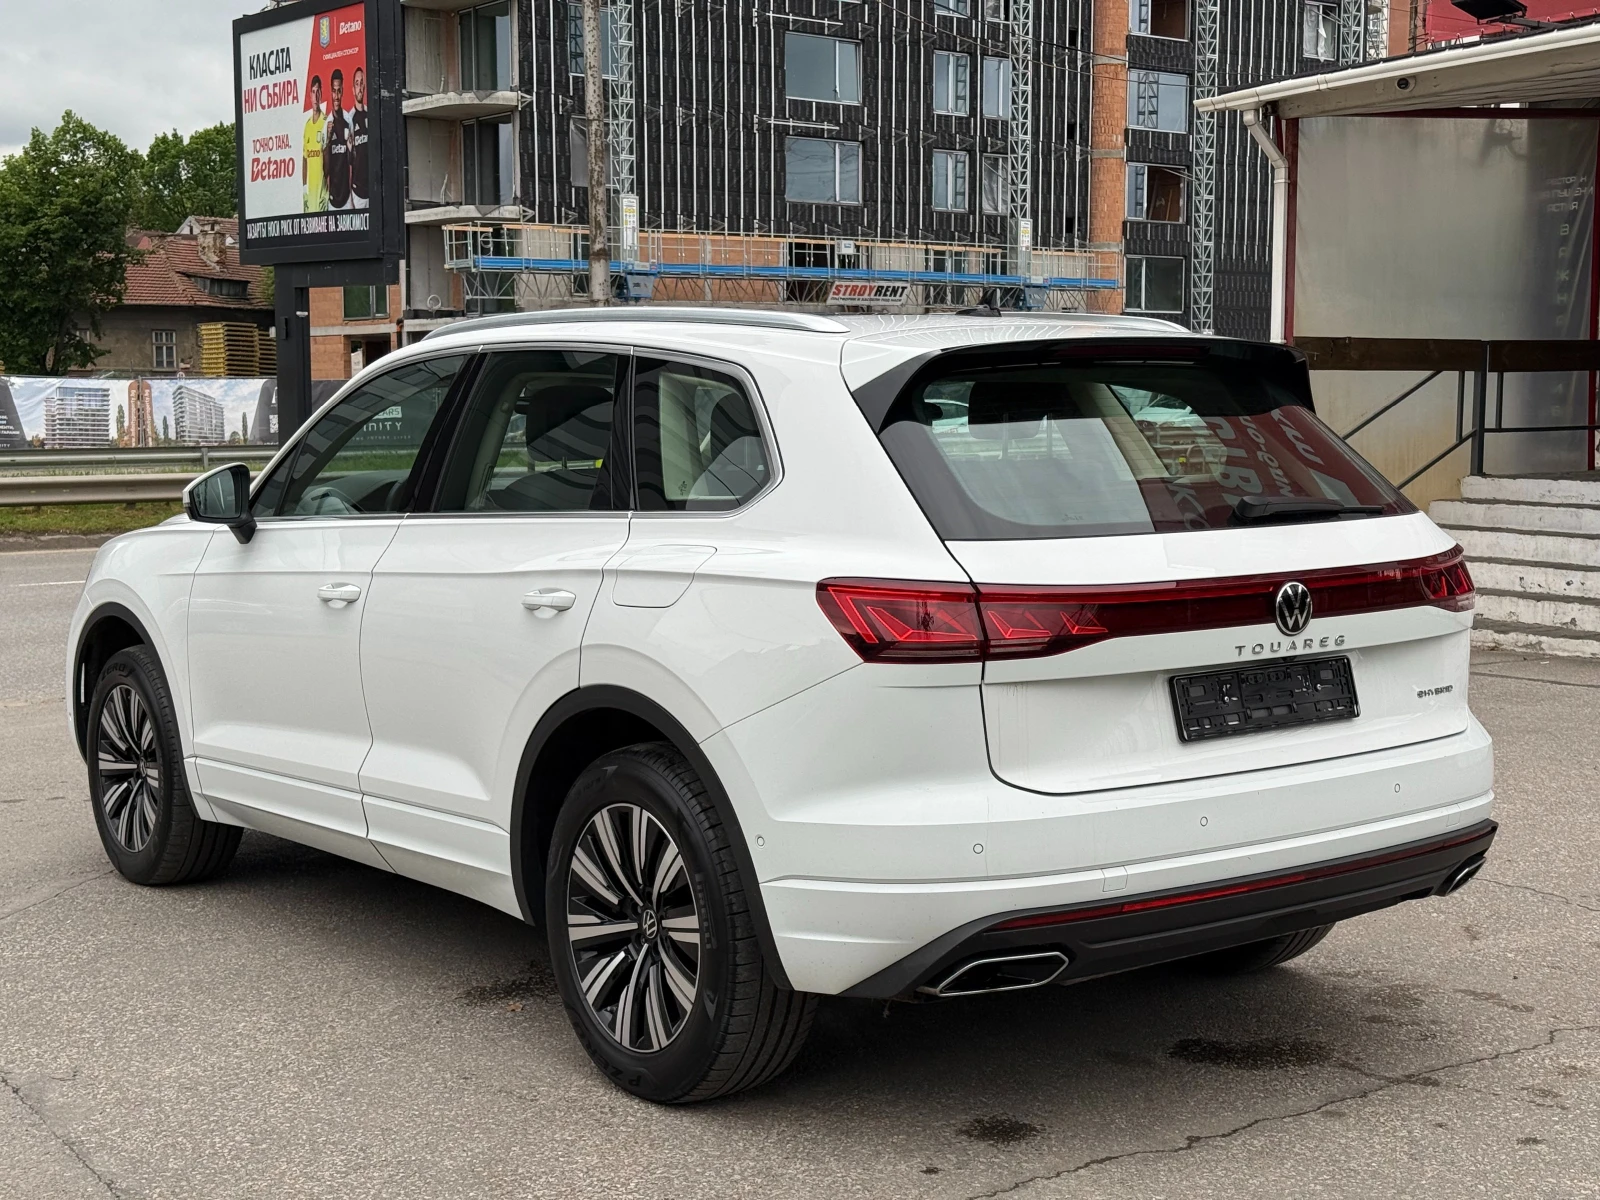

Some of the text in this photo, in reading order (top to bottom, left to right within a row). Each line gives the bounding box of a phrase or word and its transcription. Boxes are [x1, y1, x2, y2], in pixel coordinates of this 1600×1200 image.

[339, 20, 362, 35] Betano
[249, 47, 292, 80] КЛАСАТА
[243, 79, 299, 114] НИ СЪБИРА
[253, 137, 274, 154] ТОЧНО
[251, 157, 296, 182] Betano
[267, 219, 280, 238] НОСИ
[280, 218, 293, 236] РИСК
[293, 218, 300, 235] ОТ
[300, 215, 328, 235] РАЗВИВАНЕ
[328, 214, 336, 232] НА
[336, 213, 370, 231] ЗАВИСИМОСТ
[832, 284, 907, 298] STROYRENT
[1235, 635, 1346, 657] TOUAREG
